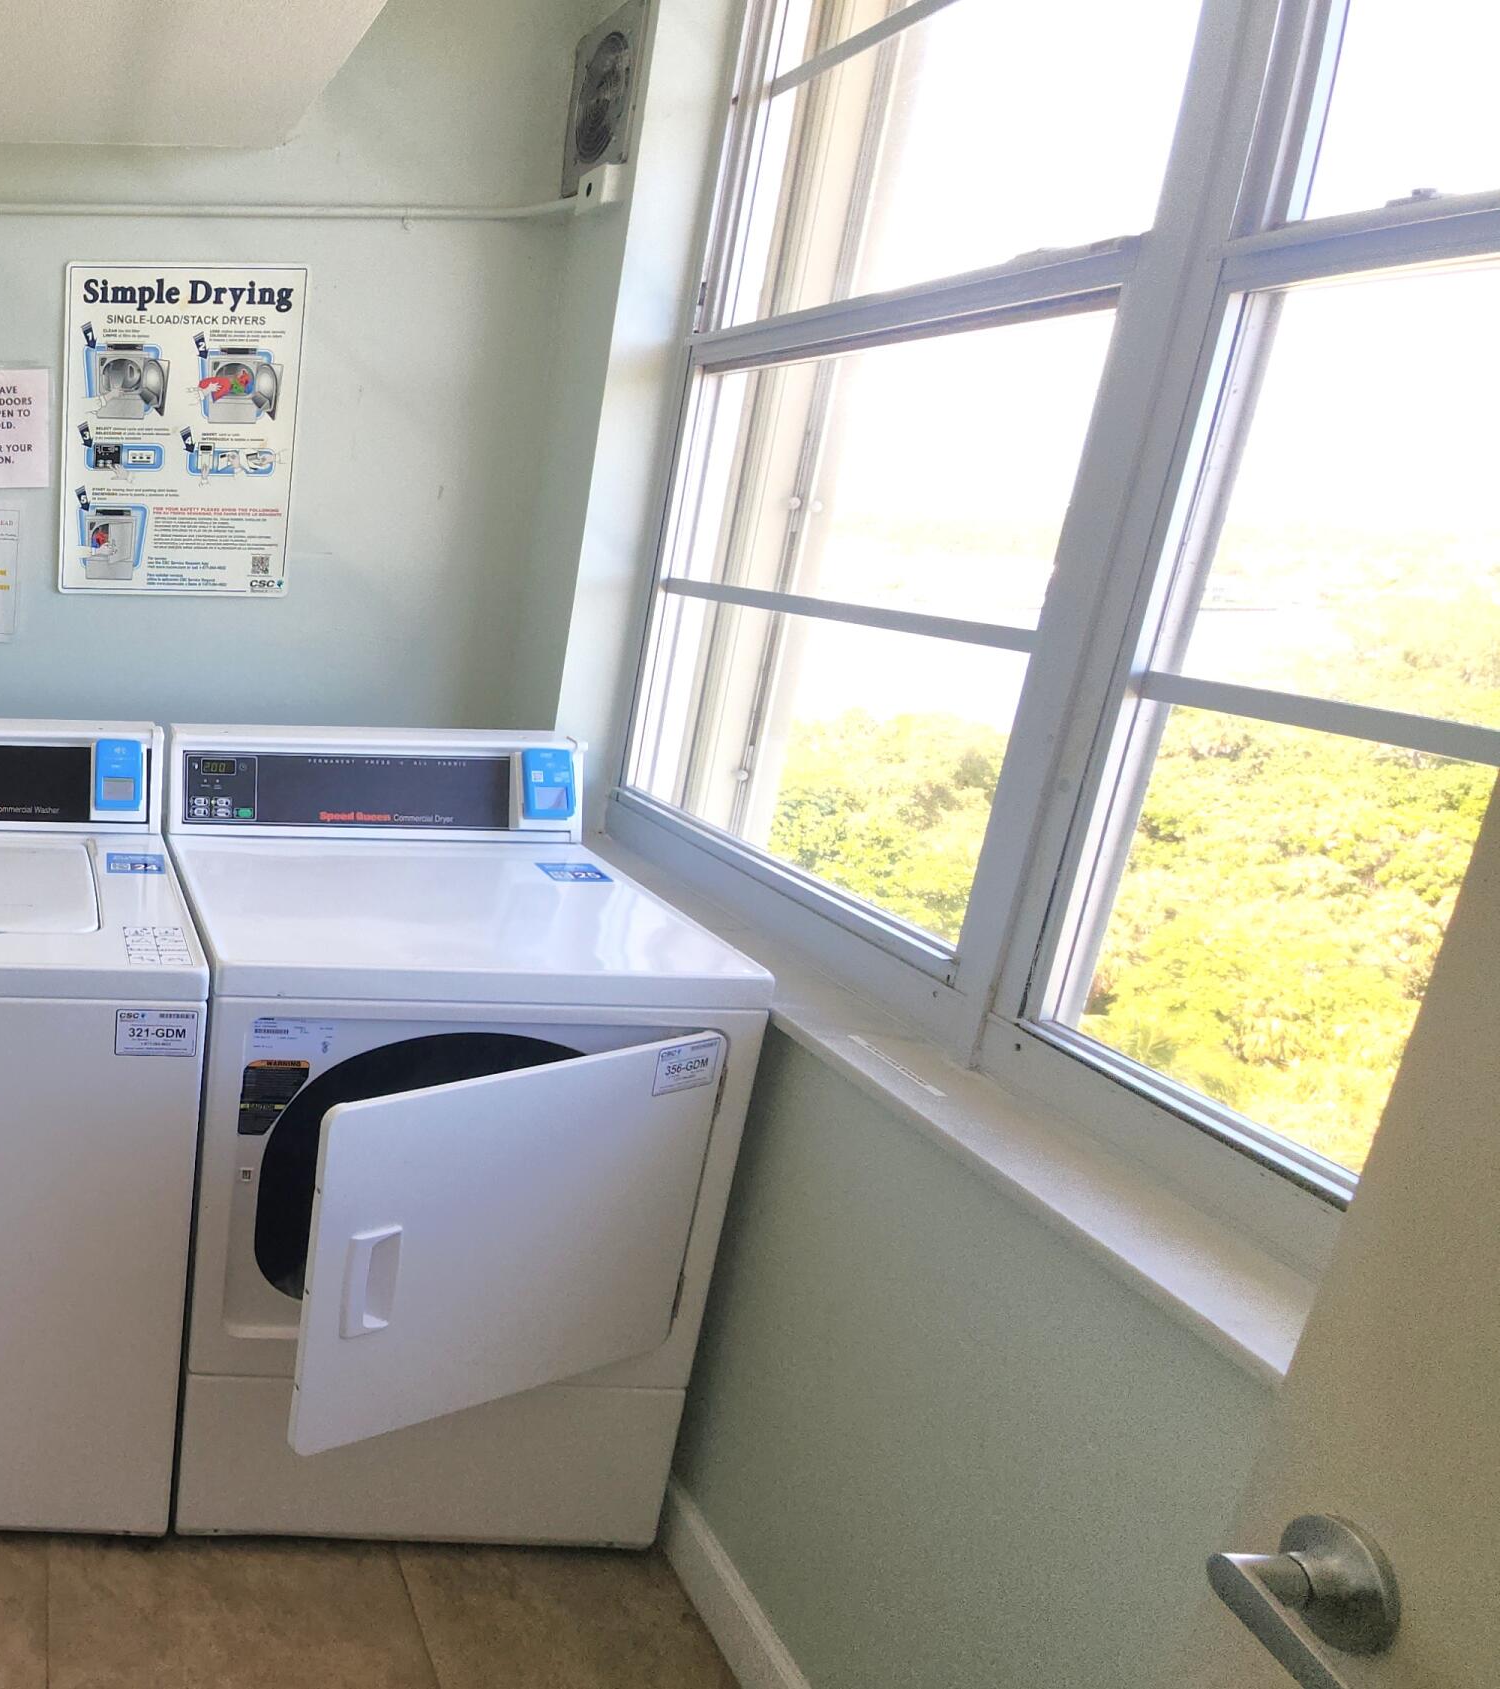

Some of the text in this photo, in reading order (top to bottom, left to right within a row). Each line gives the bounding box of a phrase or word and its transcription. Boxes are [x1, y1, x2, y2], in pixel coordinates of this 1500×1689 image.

[83, 278, 294, 313] Simple Drying
[106, 315, 266, 325] SINGLE-LOAD/STACK DRYERS
[199, 342, 206, 351] 2
[0, 397, 32, 406] DOORS
[17, 409, 31, 417] TO
[82, 432, 90, 441] 3
[6, 444, 33, 452] YOUR
[80, 495, 88, 504] 5
[249, 580, 275, 588] CSC
[34, 805, 60, 814] Washer
[319, 811, 454, 824] Speed Queen Commercial Dryer
[128, 1027, 186, 1038] 321-GDM
[664, 1057, 709, 1076] 356-GDM
